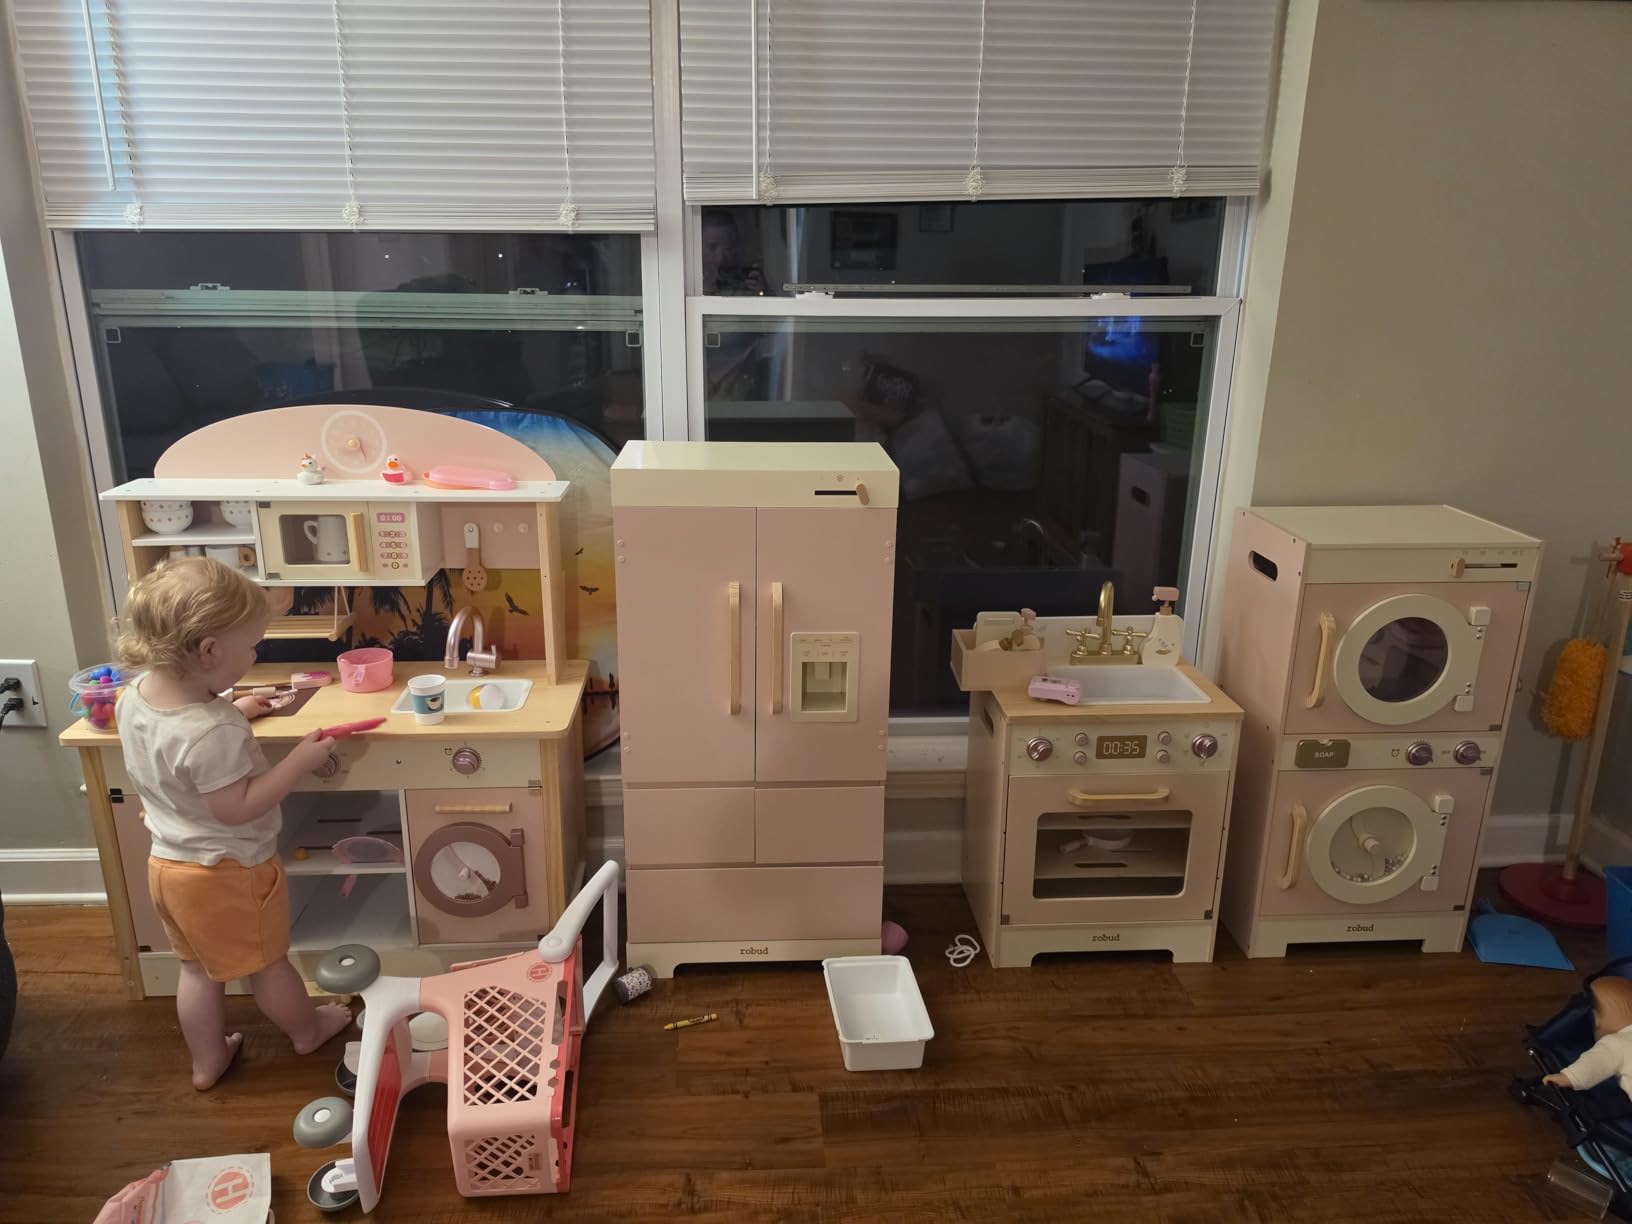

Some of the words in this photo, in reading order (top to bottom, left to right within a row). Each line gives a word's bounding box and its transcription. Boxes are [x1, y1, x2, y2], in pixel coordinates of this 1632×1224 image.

[1103, 740, 1140, 755] 00:35
[1346, 923, 1374, 932] robud
[1092, 932, 1120, 941] robud
[740, 946, 769, 955] robud
[214, 1178, 251, 1204] H
